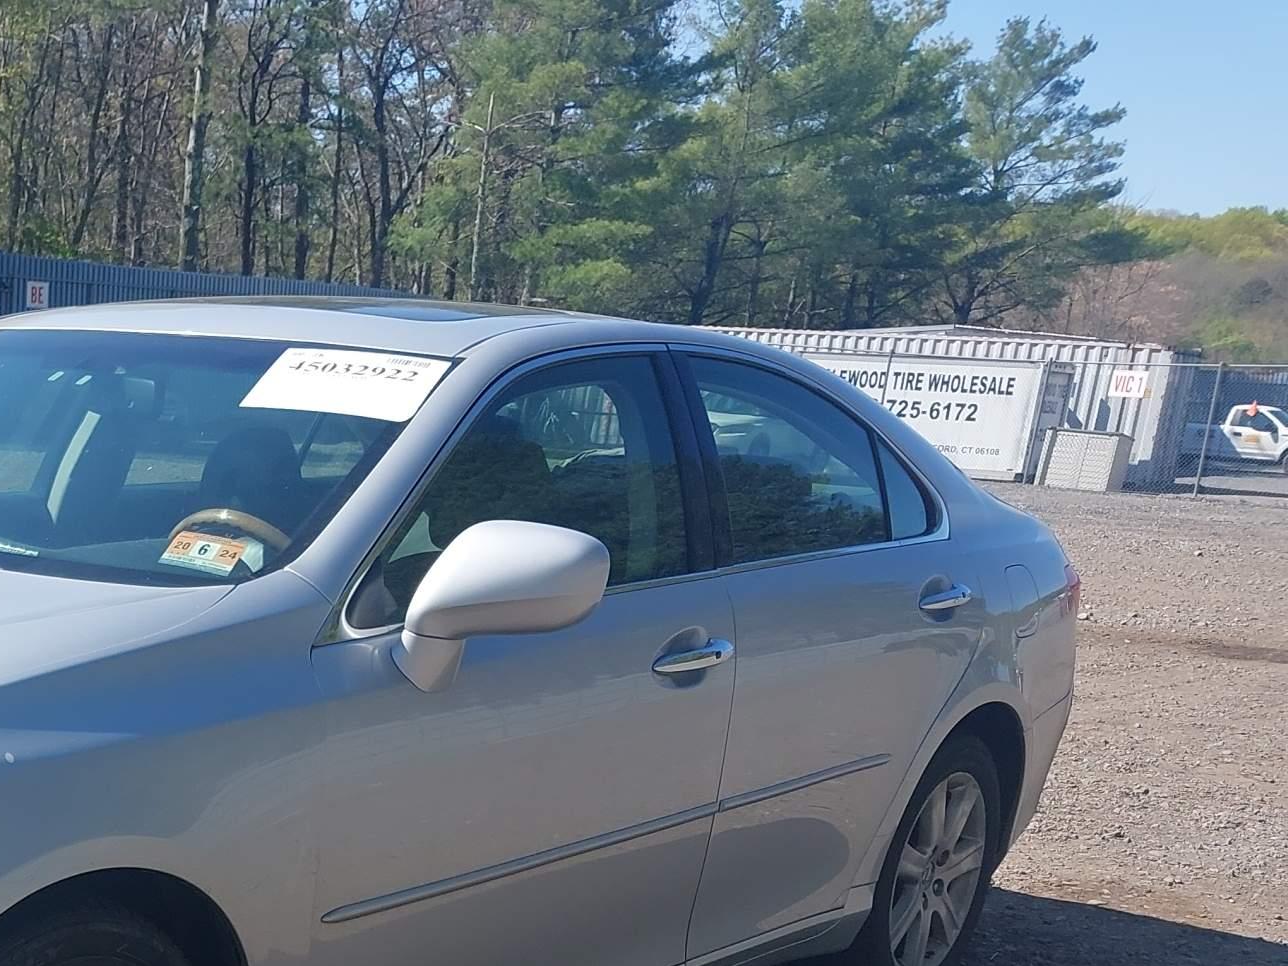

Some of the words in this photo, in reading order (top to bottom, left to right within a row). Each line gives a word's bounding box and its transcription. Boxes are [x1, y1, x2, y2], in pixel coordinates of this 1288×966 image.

[31, 286, 44, 304] BE
[289, 360, 419, 382] 45032922
[893, 371, 924, 391] TIRE
[928, 373, 1016, 396] WHOLESALE
[1115, 375, 1134, 392] VIC
[1137, 376, 1144, 393] 1
[174, 541, 191, 550] 20
[198, 543, 210, 556] 6
[219, 550, 237, 560] 24
